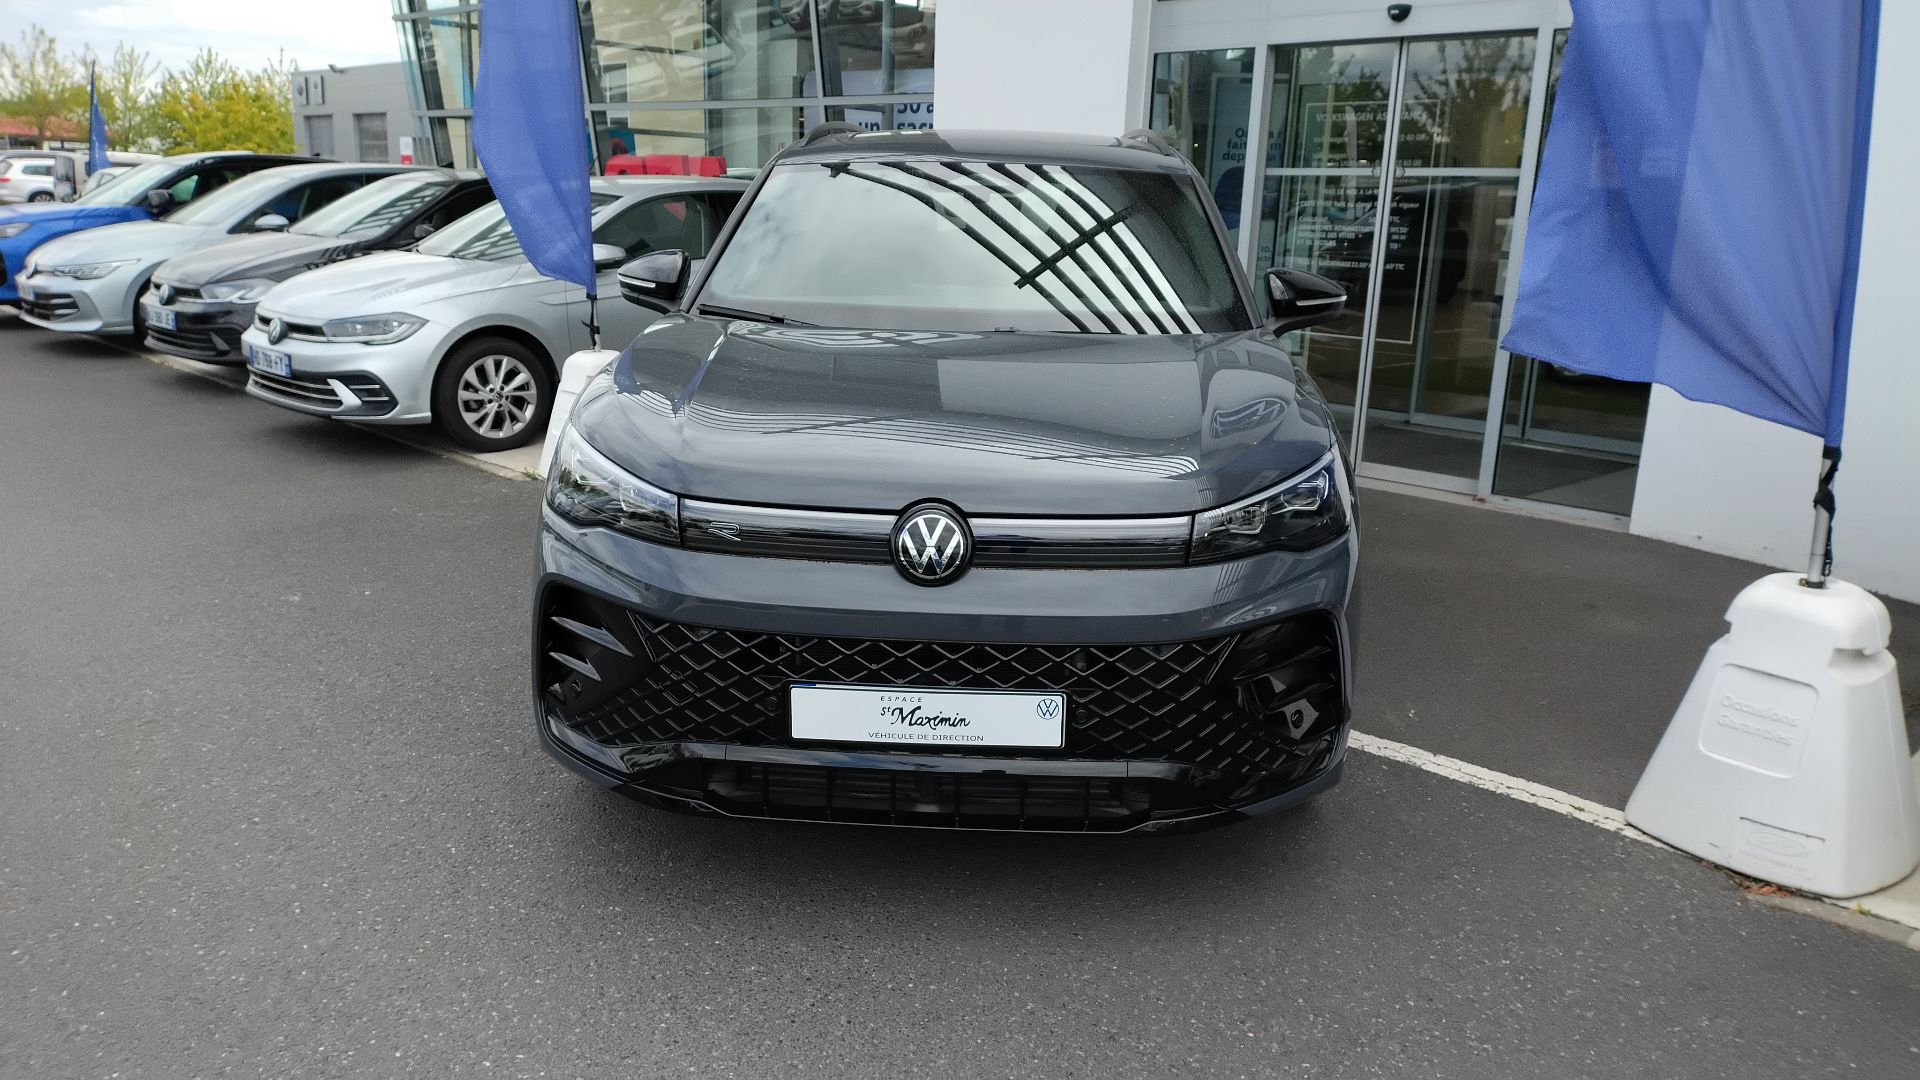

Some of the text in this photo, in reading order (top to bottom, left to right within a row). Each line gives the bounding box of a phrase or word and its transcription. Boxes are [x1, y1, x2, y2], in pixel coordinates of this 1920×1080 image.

[880, 695, 922, 703] ESPACE
[880, 705, 971, 730] St Maximin
[868, 731, 984, 742] VÉHICULE DE DIRECTION
